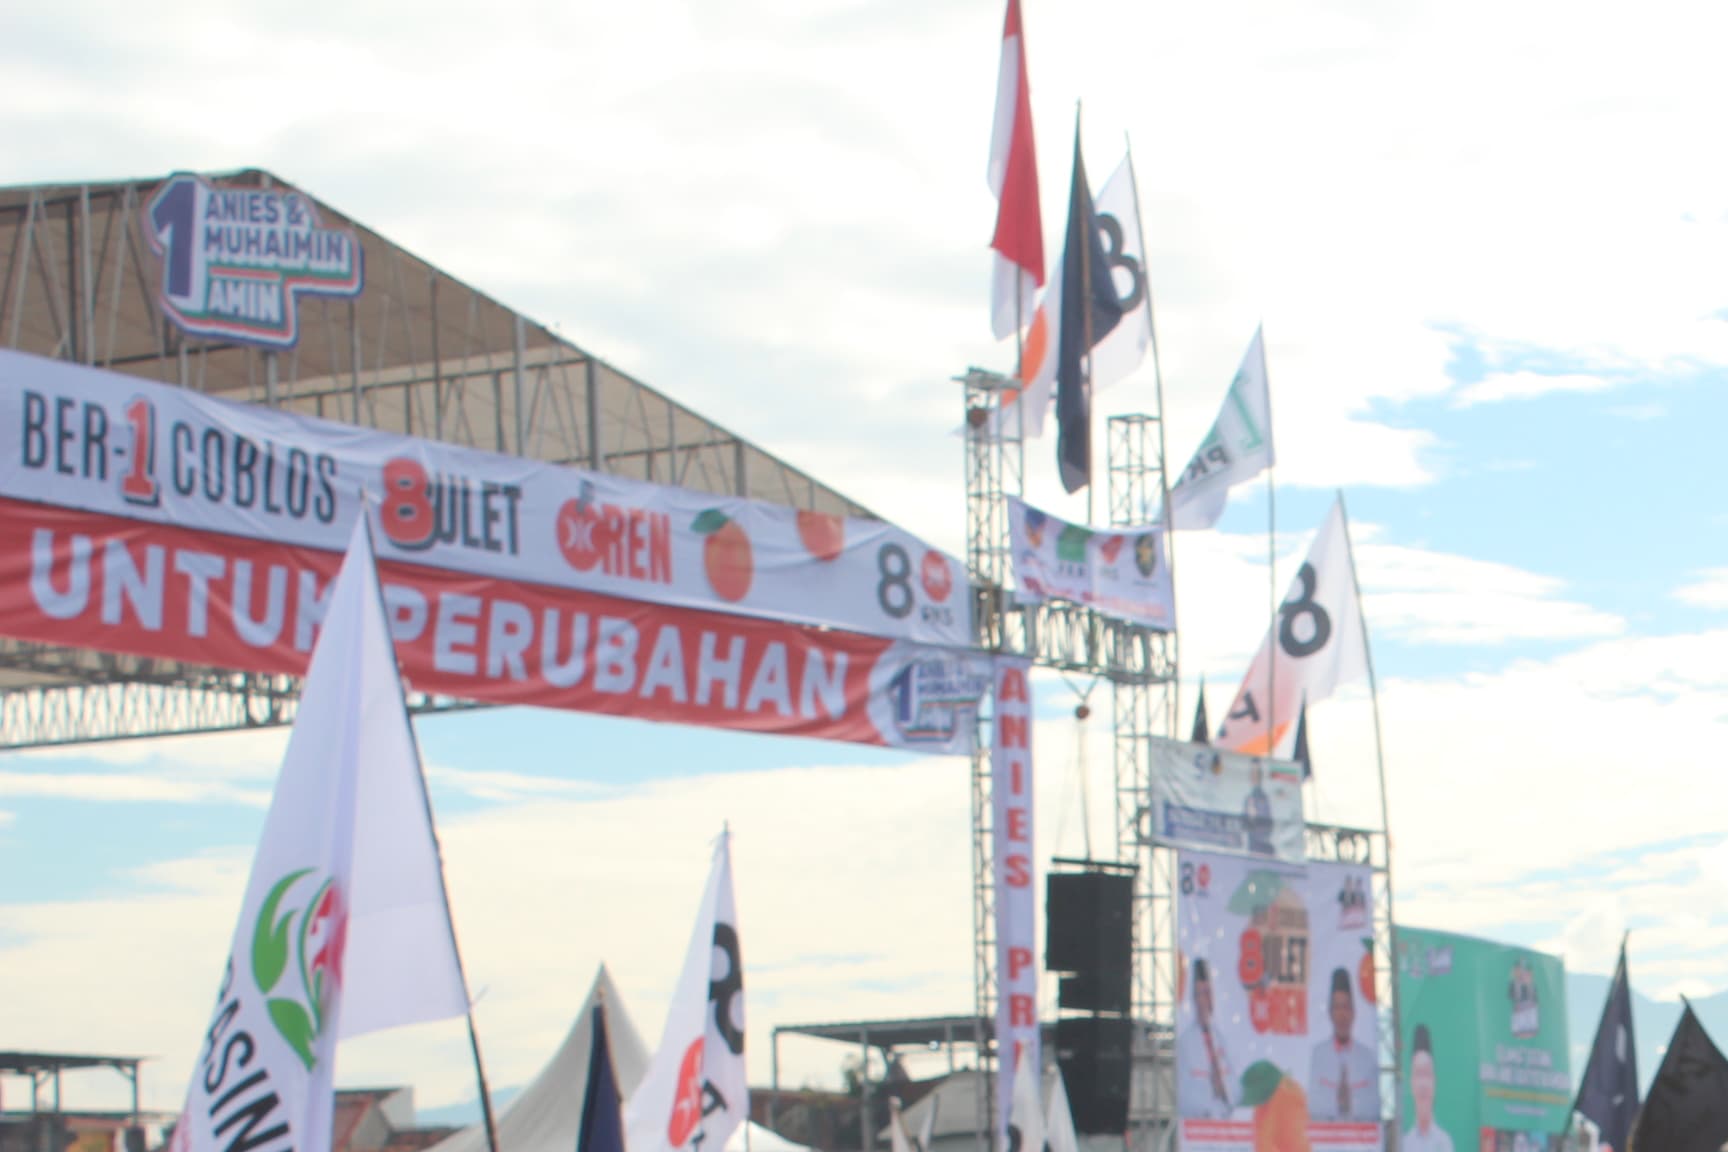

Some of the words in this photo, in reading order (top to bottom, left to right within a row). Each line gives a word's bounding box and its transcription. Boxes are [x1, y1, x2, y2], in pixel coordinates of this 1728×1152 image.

[152, 180, 196, 298] 1
[206, 191, 279, 224] ANIES
[286, 193, 305, 226] &
[206, 223, 347, 263] MUHAIMIN
[208, 279, 281, 323] AMIN
[21, 388, 161, 508] BER-1
[171, 419, 338, 524] COBLOS
[876, 541, 915, 620] 8
[382, 584, 851, 723] PERUBAHAN
[999, 667, 1030, 890] ANIES
